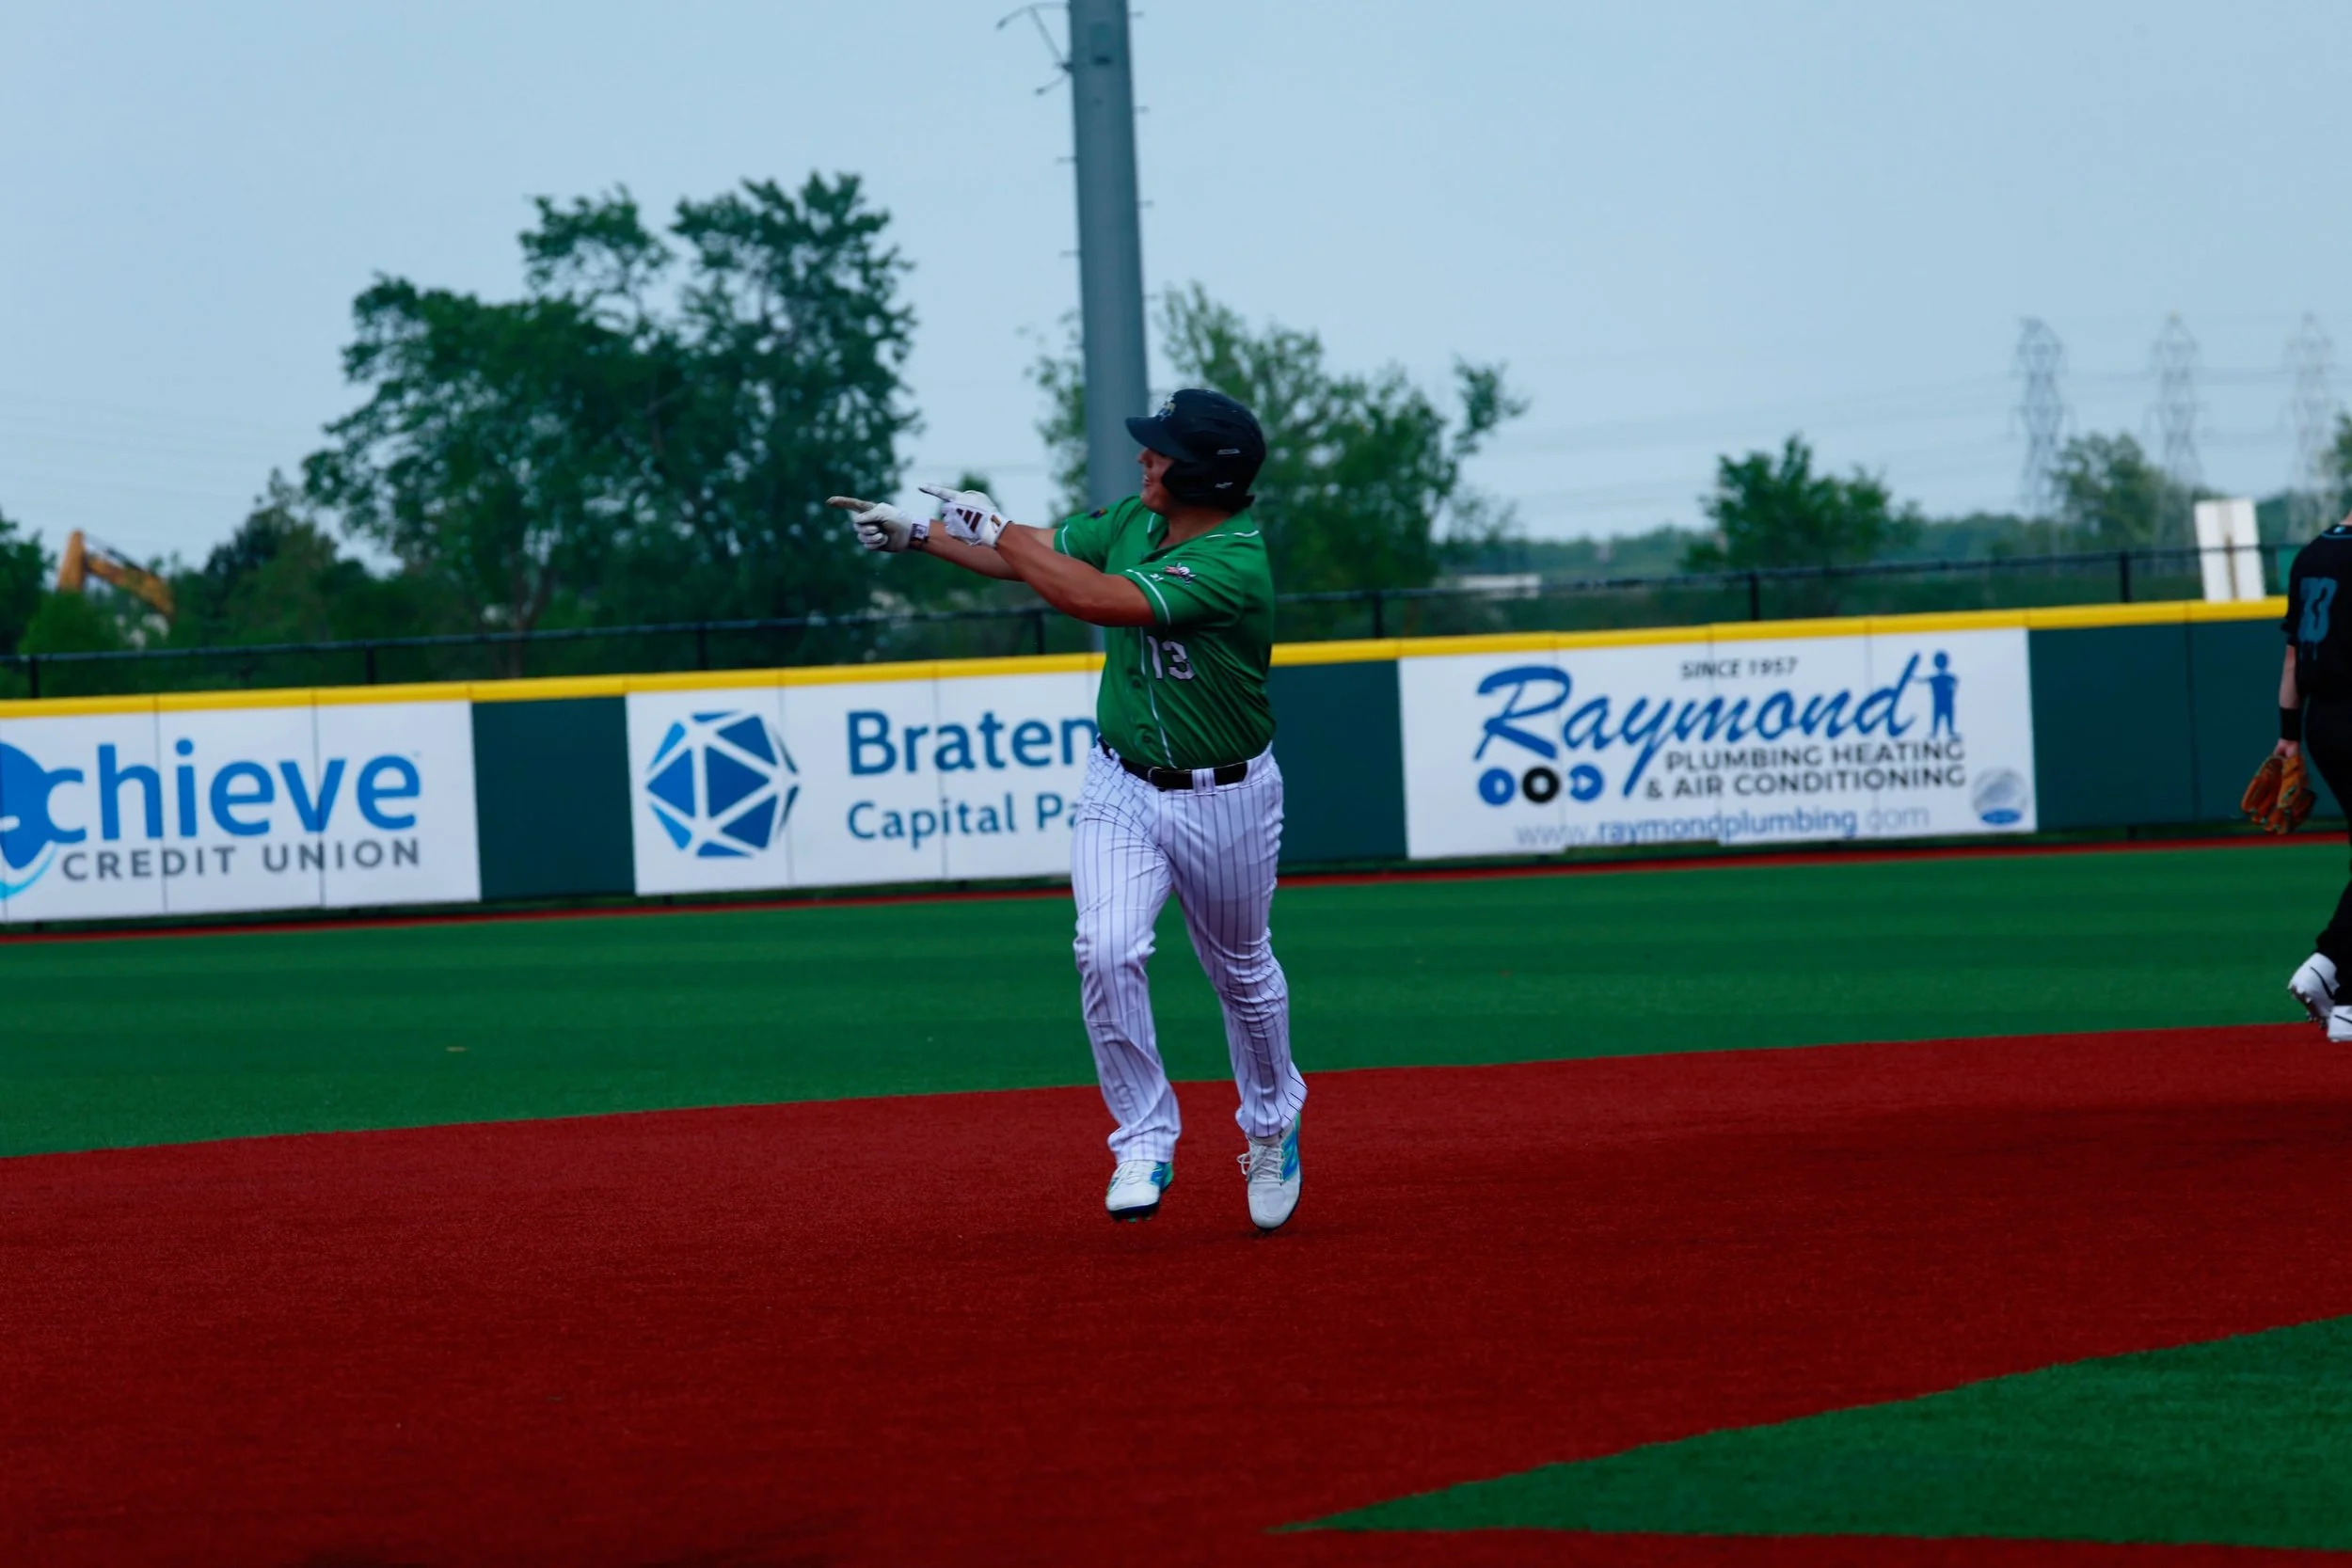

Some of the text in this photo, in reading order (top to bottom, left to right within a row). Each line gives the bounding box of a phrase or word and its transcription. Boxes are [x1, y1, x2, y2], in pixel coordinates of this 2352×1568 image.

[1148, 636, 1195, 679] 13
[1681, 657, 1798, 679] SINCE 1957
[1474, 651, 1920, 797] Raymond
[1666, 739, 1965, 771] PLUMBING HEATING
[1647, 765, 1965, 799] & AIR CONDITIONING
[849, 792, 1016, 848] Capital
[1515, 806, 1931, 846] www.raymondplumbingcom
[62, 838, 420, 881] CREDIT UNION
